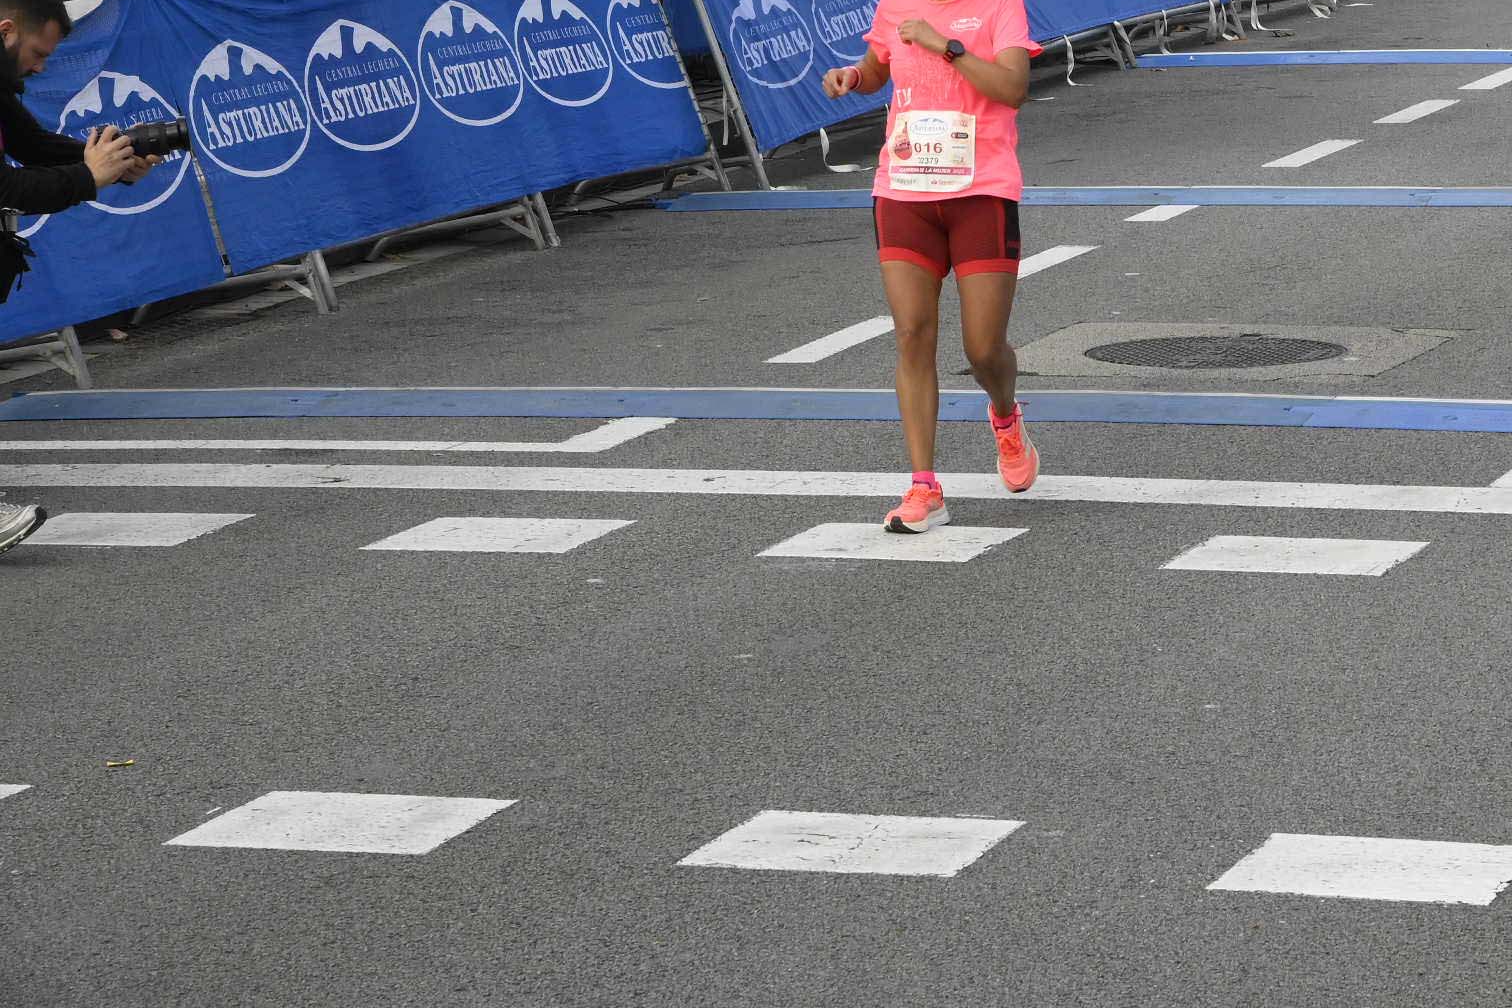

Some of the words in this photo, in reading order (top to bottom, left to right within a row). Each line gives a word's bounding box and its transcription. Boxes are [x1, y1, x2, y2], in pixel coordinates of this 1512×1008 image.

[625, 13, 656, 28] CENTRAL
[531, 29, 560, 42] CENTRAL
[561, 24, 592, 38] LECHERA
[437, 43, 470, 59] CENTRAL
[472, 39, 505, 53] LECHERA
[522, 35, 609, 81] ASTURIANA
[326, 66, 361, 82] CENTRAL
[363, 58, 400, 76] LECHERA
[427, 51, 520, 101] ASTURIANA
[212, 88, 251, 105] CENTRAL
[252, 80, 290, 98] LECHERA
[315, 74, 416, 126] ASTURIANA
[202, 97, 306, 150] ASTURIANA
[914, 142, 943, 153] 016
